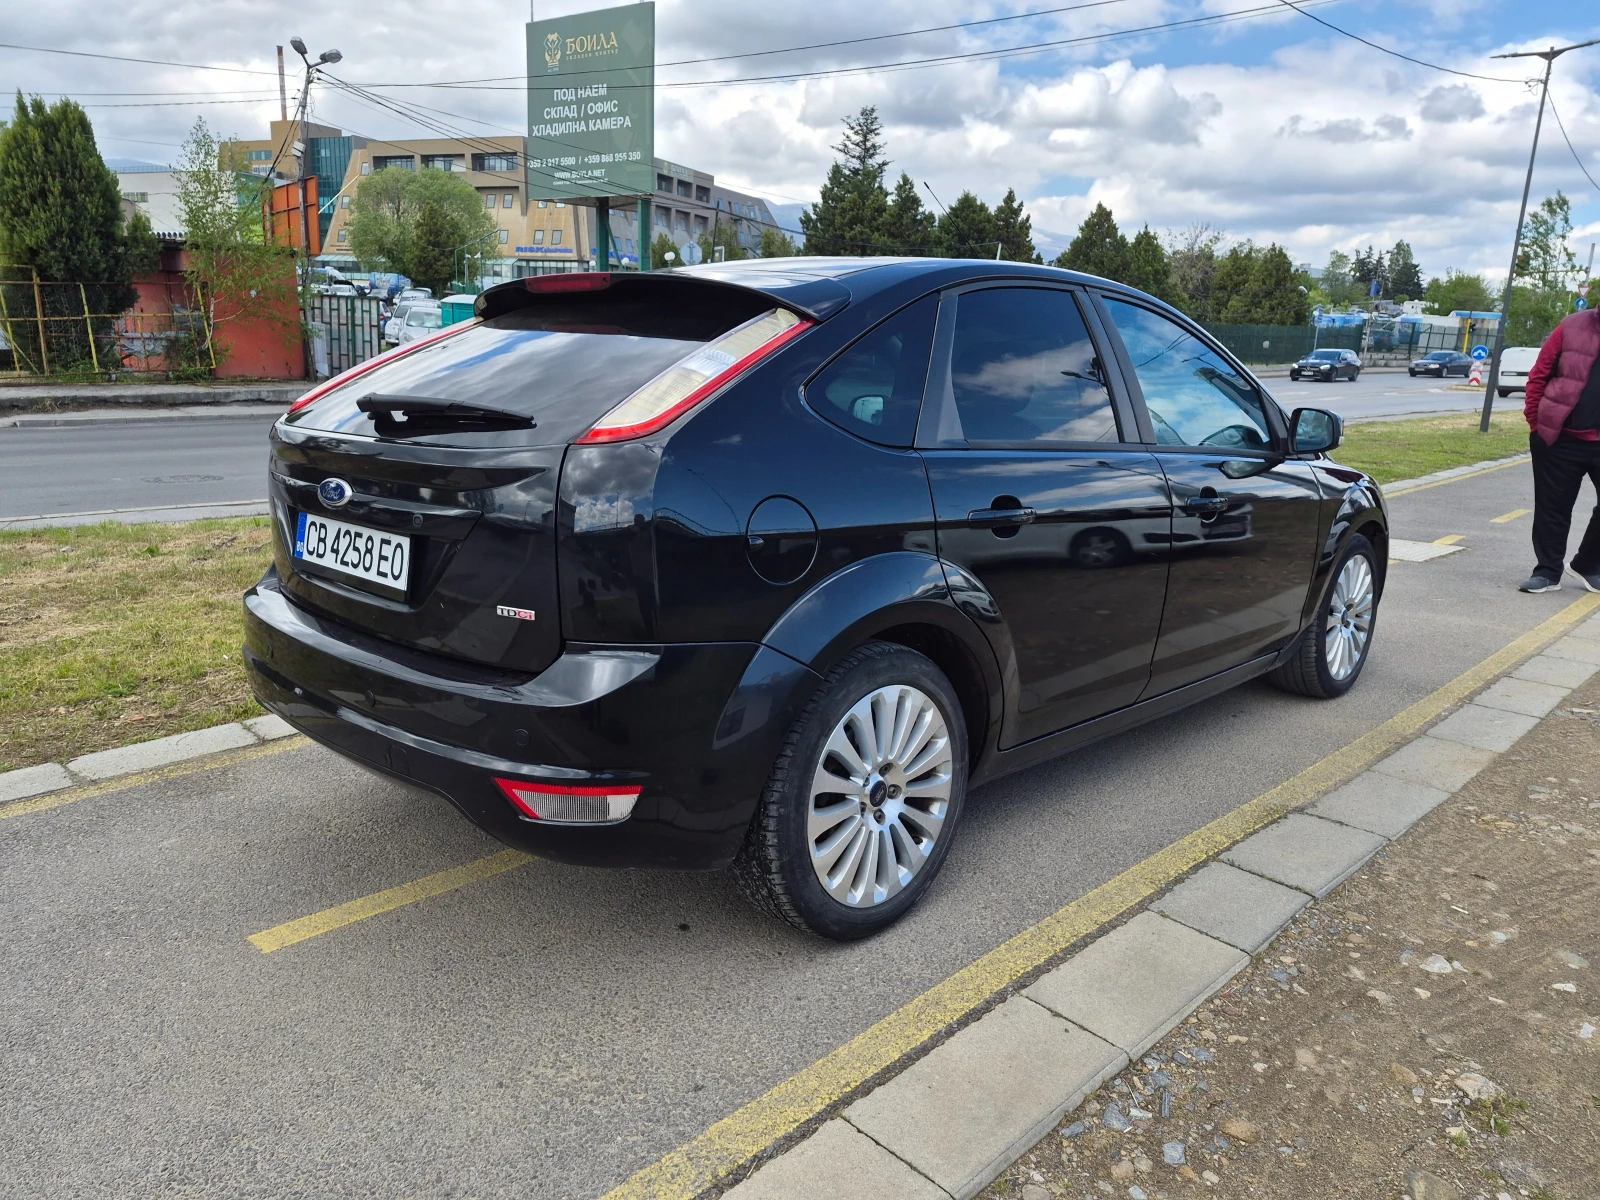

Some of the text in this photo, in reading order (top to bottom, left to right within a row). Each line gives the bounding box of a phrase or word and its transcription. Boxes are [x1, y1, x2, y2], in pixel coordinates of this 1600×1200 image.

[565, 31, 619, 55] БОИЛА
[553, 83, 607, 102] ПОД НАЕМ
[543, 104, 578, 119] СКЛАД
[587, 100, 619, 115] ОФИС
[532, 115, 632, 137] ХЛАДИЛНА КАМЕРА
[560, 156, 576, 166] 5500
[583, 154, 600, 164] +359
[628, 151, 641, 161] 350
[296, 541, 304, 552] BG
[306, 520, 328, 559] CB
[330, 527, 375, 573] 4258
[497, 606, 533, 620] TDCi
